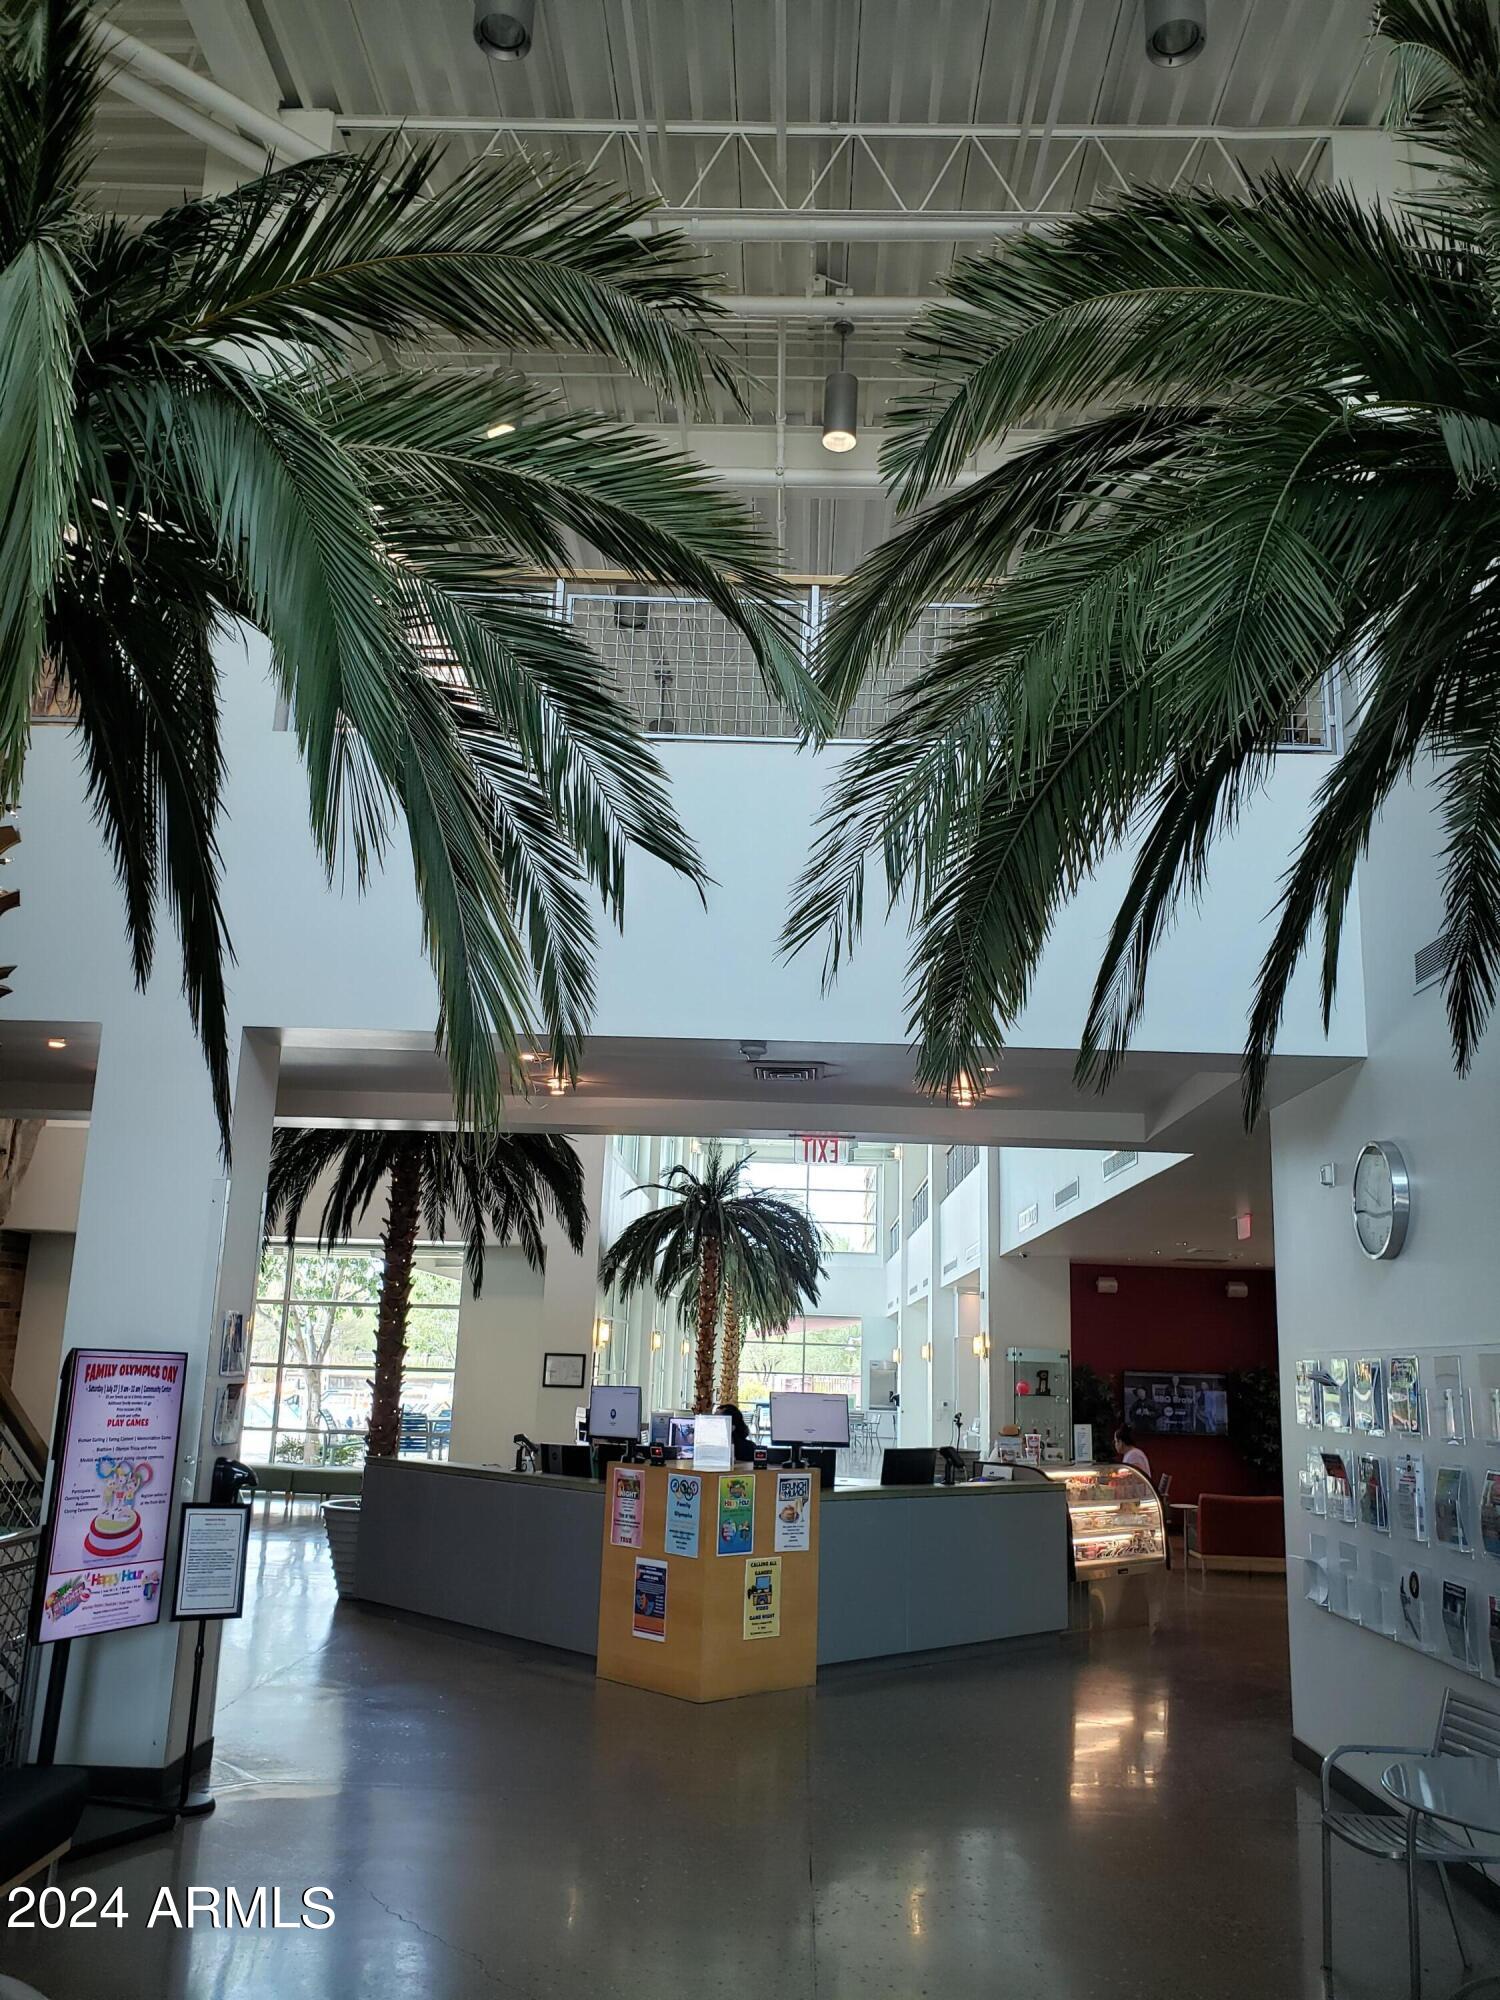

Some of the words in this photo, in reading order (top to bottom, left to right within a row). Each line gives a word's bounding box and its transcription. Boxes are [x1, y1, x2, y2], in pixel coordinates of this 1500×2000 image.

[85, 1363, 118, 1383] FAMILY
[119, 1363, 161, 1379] OLYMPICS
[162, 1365, 179, 1384] DAY
[107, 1418, 124, 1428] PLAY
[126, 1418, 149, 1427] GAMES
[782, 1481, 807, 1491] BRUNCH
[91, 1572, 119, 1588] Happy
[121, 1569, 144, 1582] Hour
